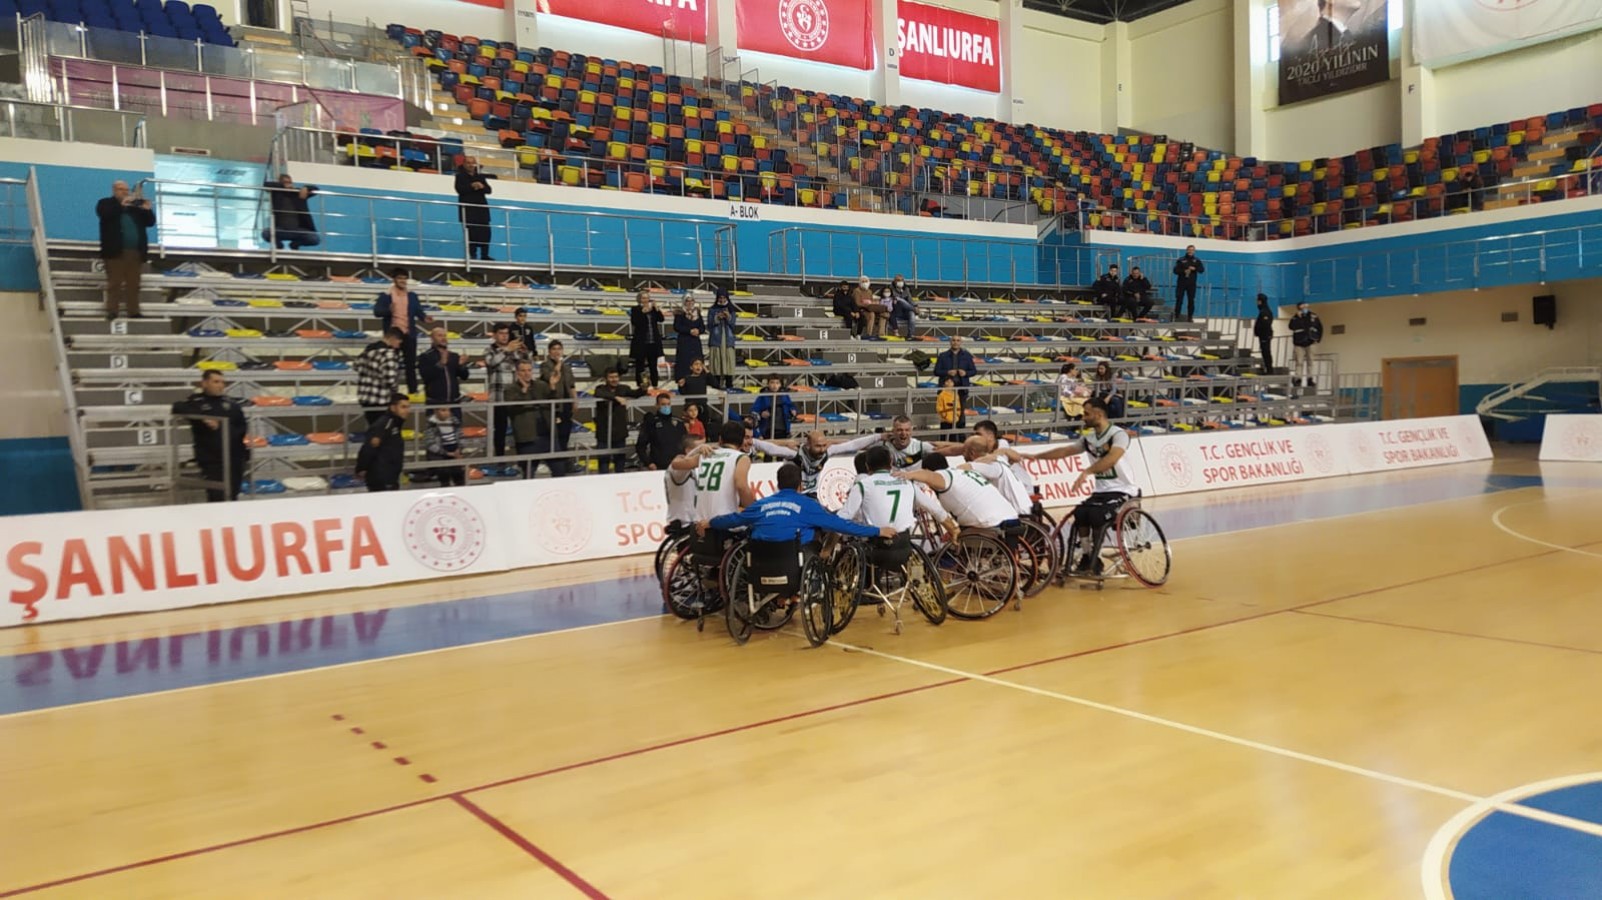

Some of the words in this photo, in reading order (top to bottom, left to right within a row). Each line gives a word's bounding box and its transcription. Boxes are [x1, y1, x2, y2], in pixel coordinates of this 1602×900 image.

[889, 48, 895, 56] D
[897, 18, 994, 66] ŞANLIURFA
[1287, 62, 1320, 81] 2020
[740, 206, 759, 219] BLOK
[115, 322, 124, 332] E
[113, 356, 124, 368] D
[129, 391, 139, 402] C
[143, 431, 153, 443] B
[1200, 445, 1224, 460] T.C.
[1225, 438, 1277, 460] GENÇLİK
[1277, 439, 1295, 454] VE
[1063, 456, 1086, 473] VE
[1203, 466, 1239, 484] SPOR
[1239, 457, 1304, 480] BAKANLIĞI
[698, 461, 725, 492] 28
[616, 489, 661, 513] T.C.
[887, 489, 901, 523] 7
[615, 521, 667, 547] SPO
[6, 515, 389, 619] ŞANLIURFA
